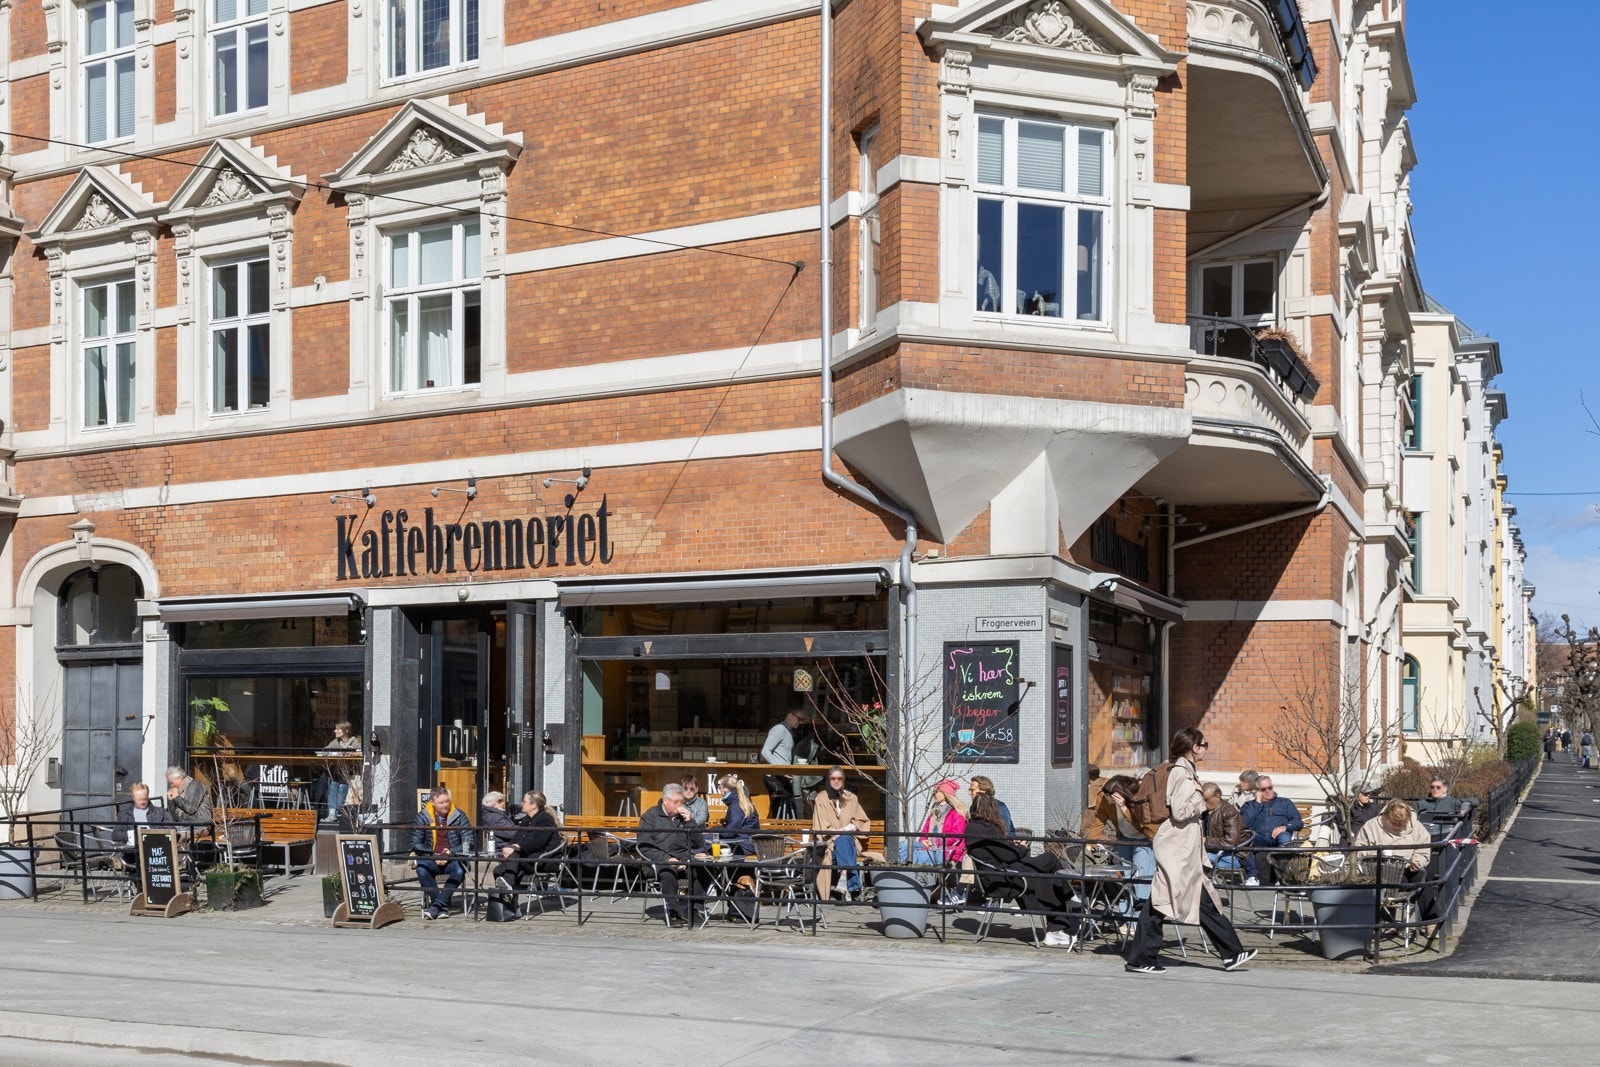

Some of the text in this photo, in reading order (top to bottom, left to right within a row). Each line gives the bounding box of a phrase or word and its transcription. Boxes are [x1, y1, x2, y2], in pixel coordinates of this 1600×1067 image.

[335, 492, 614, 580] Kaffebrenneriet
[982, 619, 1036, 628] Frognerveien
[316, 628, 347, 638] HASLE
[960, 663, 973, 684] Vi
[962, 686, 1003, 702] iskrem
[966, 705, 1002, 726] beger
[259, 764, 288, 784] Kaffe
[259, 783, 288, 793] brenneriet
[149, 857, 167, 865] RABATT
